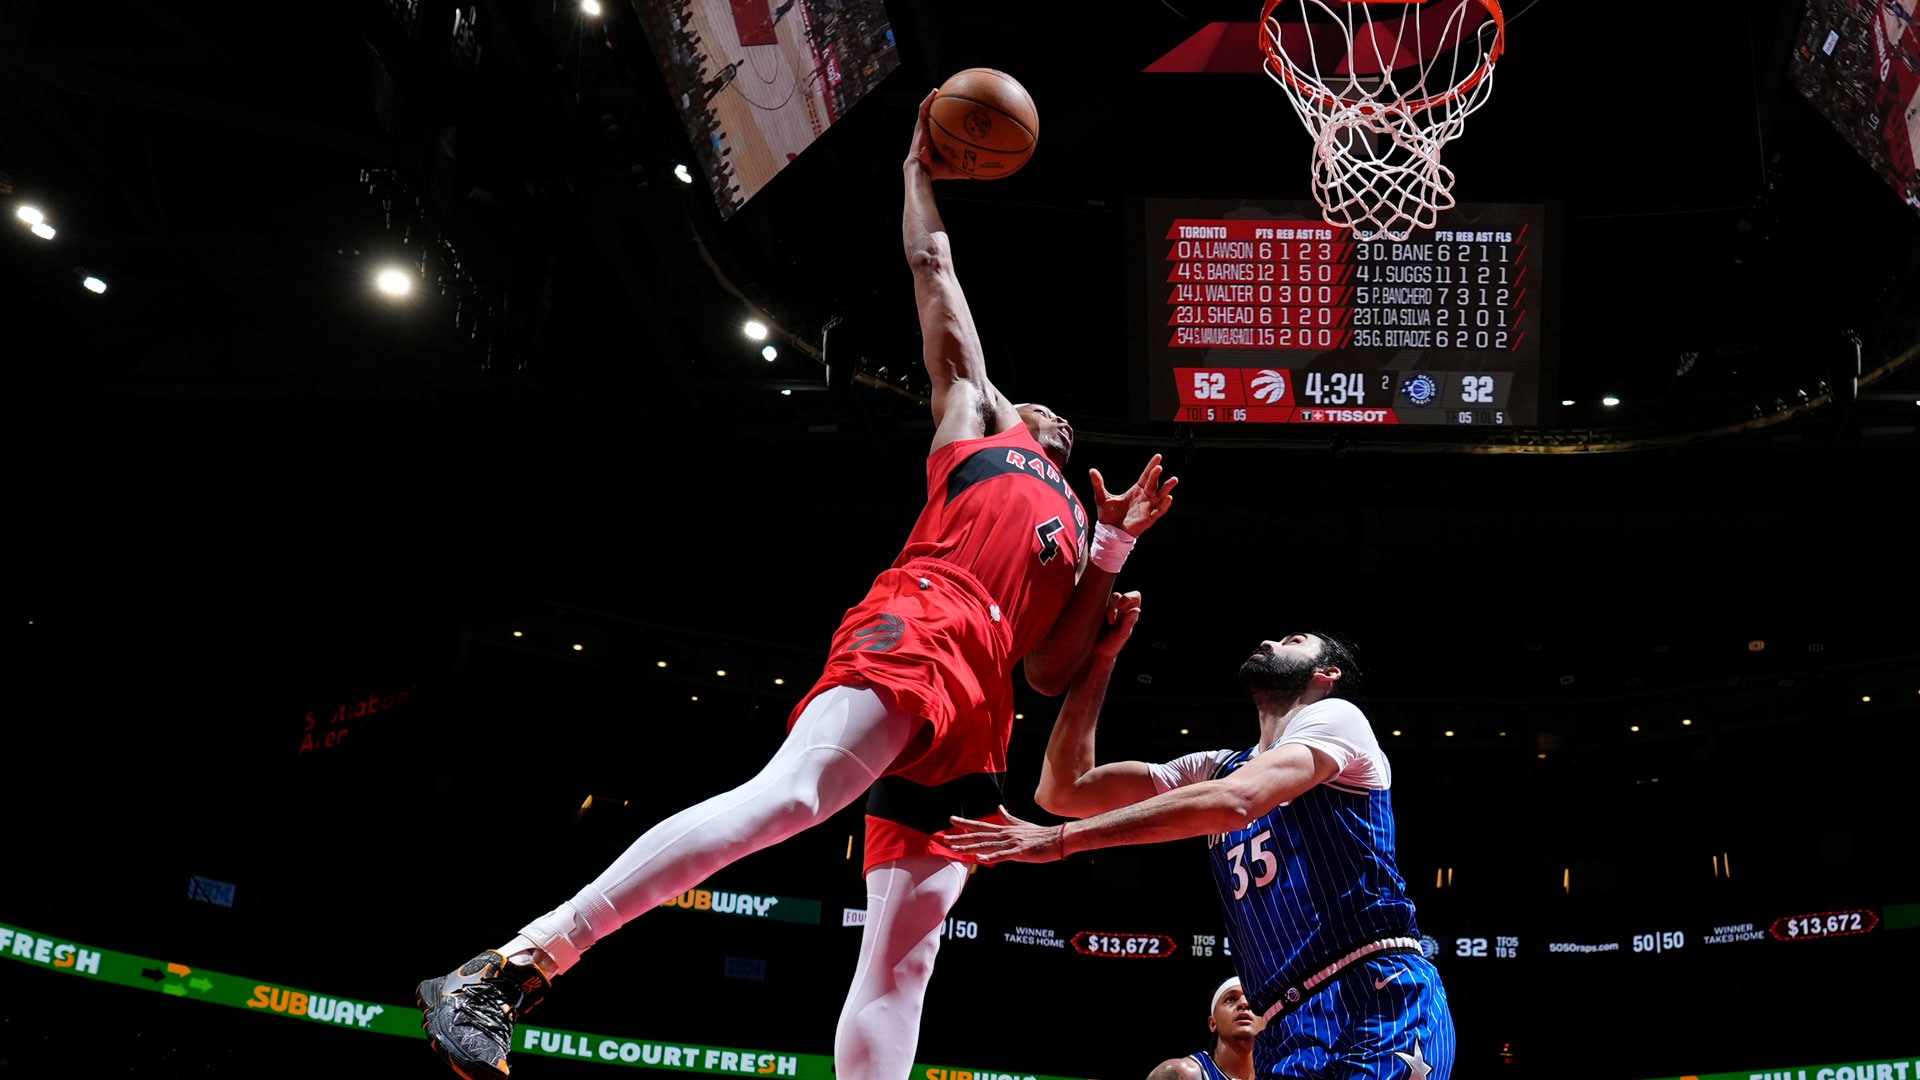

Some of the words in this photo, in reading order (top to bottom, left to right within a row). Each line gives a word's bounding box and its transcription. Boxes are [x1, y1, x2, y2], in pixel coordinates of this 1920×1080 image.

[1179, 226, 1226, 239] TORONTO
[1256, 229, 1273, 239] PTS
[1277, 229, 1294, 239] REB
[1296, 229, 1314, 239] AST
[1316, 230, 1331, 240] FLS
[1436, 231, 1453, 241] PTS
[1456, 232, 1473, 242] REB
[1476, 232, 1493, 242] AST
[1496, 232, 1511, 242] FLS
[1179, 241, 1190, 258] 0
[1193, 242, 1204, 258] A.
[1207, 242, 1253, 259] LAWSON
[1260, 242, 1271, 259] 6
[1281, 243, 1289, 259] 1
[1300, 243, 1311, 260] 2
[1319, 243, 1330, 260] 3
[1357, 244, 1369, 260] 3
[1374, 244, 1387, 260] D.
[1393, 244, 1433, 261] BANE
[1438, 245, 1450, 261] 6
[1459, 245, 1470, 261] 2
[1480, 245, 1488, 262] 1
[1500, 245, 1508, 262] 1
[1178, 263, 1190, 279] 4
[1194, 263, 1204, 280] S.
[1208, 263, 1253, 280] BARNES
[1258, 264, 1274, 280] 12
[1281, 264, 1290, 281] 1
[1300, 265, 1311, 281] 5
[1319, 265, 1330, 281] 0
[1357, 266, 1369, 281] 4
[1373, 266, 1382, 282] J.
[1386, 266, 1431, 283] SUGGS
[1436, 266, 1451, 283] 11
[1460, 267, 1468, 283] 1
[1478, 267, 1489, 283] 2
[1499, 267, 1507, 284] 1
[1177, 284, 1192, 301] 14
[1194, 285, 1203, 301] J.
[1206, 285, 1253, 302] WALTER
[1260, 286, 1271, 302] 0
[1280, 286, 1291, 302] 3
[1299, 286, 1311, 302] 0
[1319, 286, 1330, 303] 0
[1357, 287, 1368, 303] 5
[1373, 287, 1380, 303] P.
[1383, 287, 1432, 304] BANCHERO
[1438, 288, 1448, 304] 7
[1457, 289, 1469, 305] 3
[1479, 289, 1487, 305] 1
[1497, 289, 1508, 305] 2
[1177, 306, 1193, 323] 23
[1195, 307, 1204, 323] J.
[1208, 307, 1253, 323] SHEAD
[1260, 307, 1271, 324] 6
[1281, 308, 1290, 324] 1
[1300, 308, 1311, 324] 2
[1319, 308, 1330, 324] 0
[1354, 308, 1371, 324] 23
[1372, 308, 1381, 325] T.
[1384, 309, 1398, 325] DA
[1400, 309, 1430, 325] SILVA
[1437, 309, 1448, 326] 2
[1459, 310, 1467, 326] 1
[1477, 310, 1488, 326] 0
[1498, 310, 1506, 326] 1
[1178, 327, 1193, 344] 54
[1258, 329, 1274, 345] 15
[1280, 329, 1291, 345] 2
[1300, 329, 1311, 345] 0
[1319, 329, 1330, 345] 0
[1354, 330, 1371, 346] 35
[1373, 330, 1383, 346] G.
[1386, 330, 1430, 347] BITADZE
[1437, 331, 1448, 347] 6
[1457, 331, 1468, 347] 2
[1476, 331, 1488, 347] 0
[1496, 332, 1507, 348] 2
[1194, 372, 1226, 399] 52
[1305, 372, 1365, 404] 4:34
[1382, 375, 1389, 390] 2
[1462, 376, 1493, 403] 32
[1207, 408, 1214, 420] 5
[1233, 409, 1246, 420] 05
[1324, 410, 1387, 422] TISSOT
[1459, 412, 1472, 423] 05
[1496, 412, 1503, 423] 5
[1035, 516, 1065, 567] 4
[1226, 828, 1279, 901] 35
[1016, 926, 1054, 938] WINNER
[1713, 922, 1754, 935] WINNER
[1788, 913, 1862, 938] $13,672
[1004, 933, 1034, 945] TAKES
[1036, 937, 1065, 948] HOME
[1088, 935, 1160, 957] $13,672
[1193, 935, 1216, 946] TF05
[1496, 936, 1520, 947] TF05
[1703, 934, 1734, 944] TAKES
[1735, 930, 1765, 942] HOME
[0, 927, 101, 975] FRESH
[1192, 946, 1202, 957] TO
[1456, 937, 1488, 958] 32
[1495, 947, 1507, 958] TO
[1508, 948, 1517, 958] 5
[1549, 942, 1619, 954] 5050raps.com
[246, 984, 384, 1028] SUBWAY
[524, 1029, 593, 1058] FULL
[598, 1040, 699, 1068] COURT
[704, 1050, 797, 1077] FRESH
